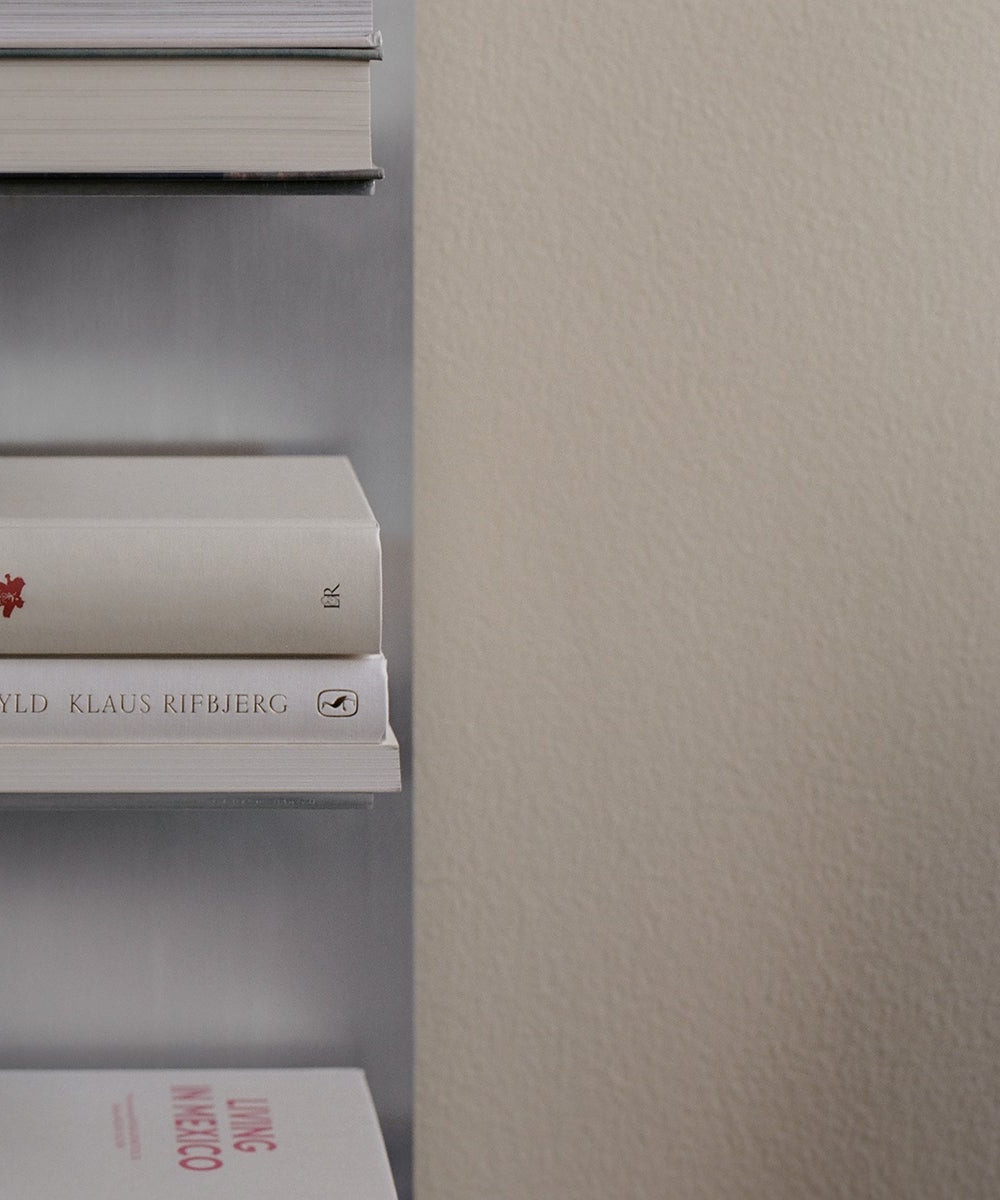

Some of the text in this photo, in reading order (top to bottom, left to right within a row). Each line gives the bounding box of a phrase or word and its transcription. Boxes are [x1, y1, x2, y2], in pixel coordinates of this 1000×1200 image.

[69, 693, 151, 715] KLAUS
[163, 693, 288, 715] RIFBJERG
[170, 1084, 223, 1171] IN MEXICO
[226, 1099, 277, 1153] LIVING
